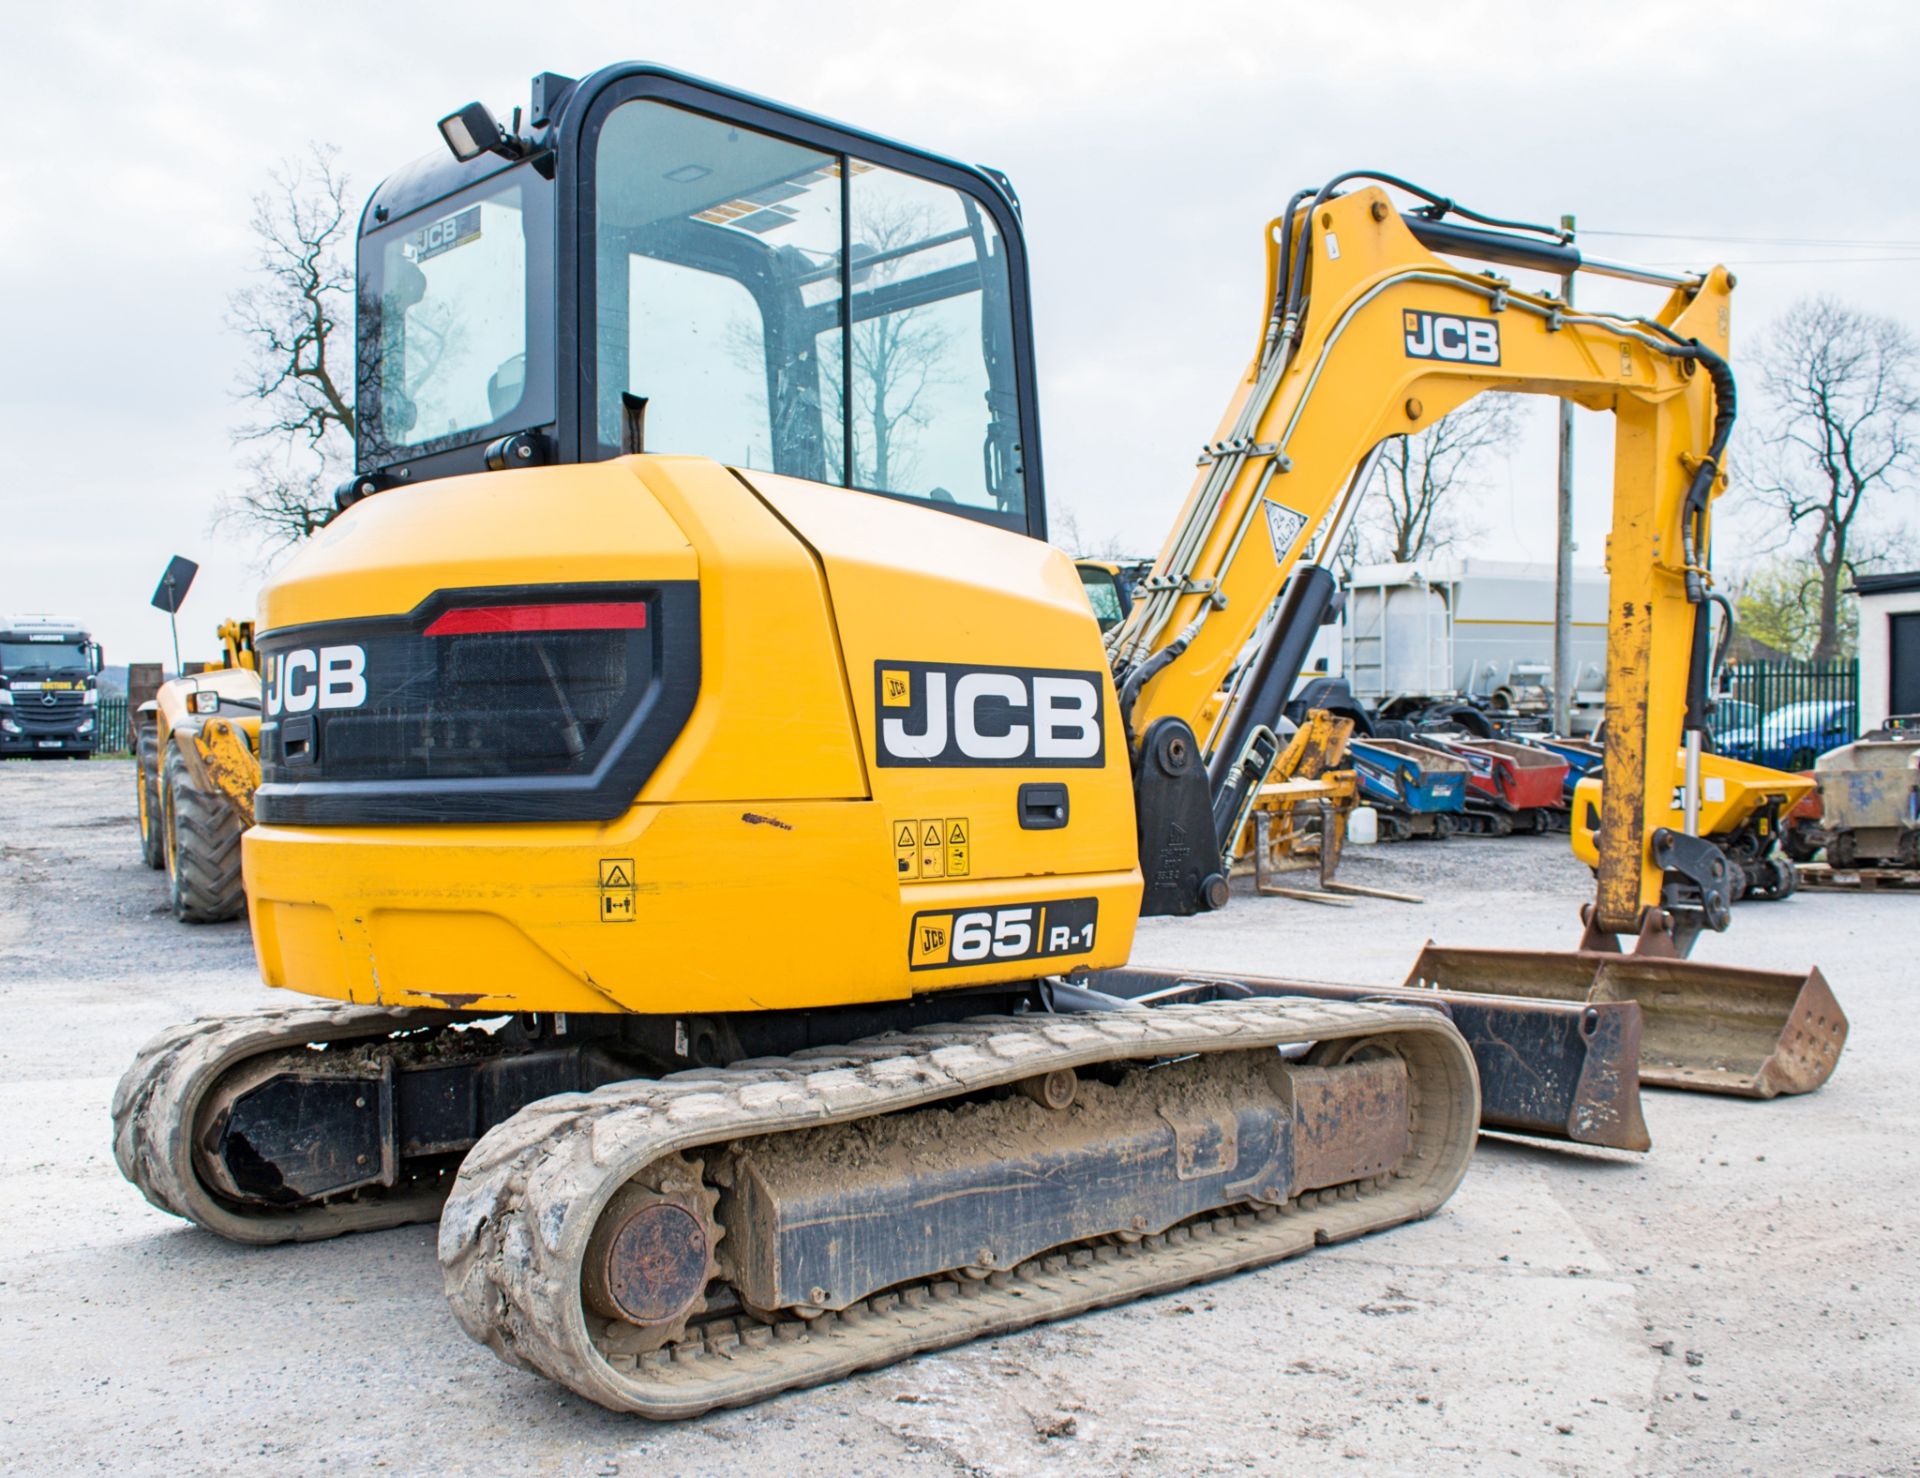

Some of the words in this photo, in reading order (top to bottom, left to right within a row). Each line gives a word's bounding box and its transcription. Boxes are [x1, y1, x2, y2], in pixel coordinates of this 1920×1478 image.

[417, 218, 457, 254] JCB
[1406, 315, 1500, 363] JCB
[267, 645, 367, 716] JCB
[889, 679, 906, 697] JCB
[882, 672, 1101, 759] JCB
[923, 929, 945, 952] JCB
[952, 908, 1032, 961] 65
[1049, 923, 1094, 952] R-1
